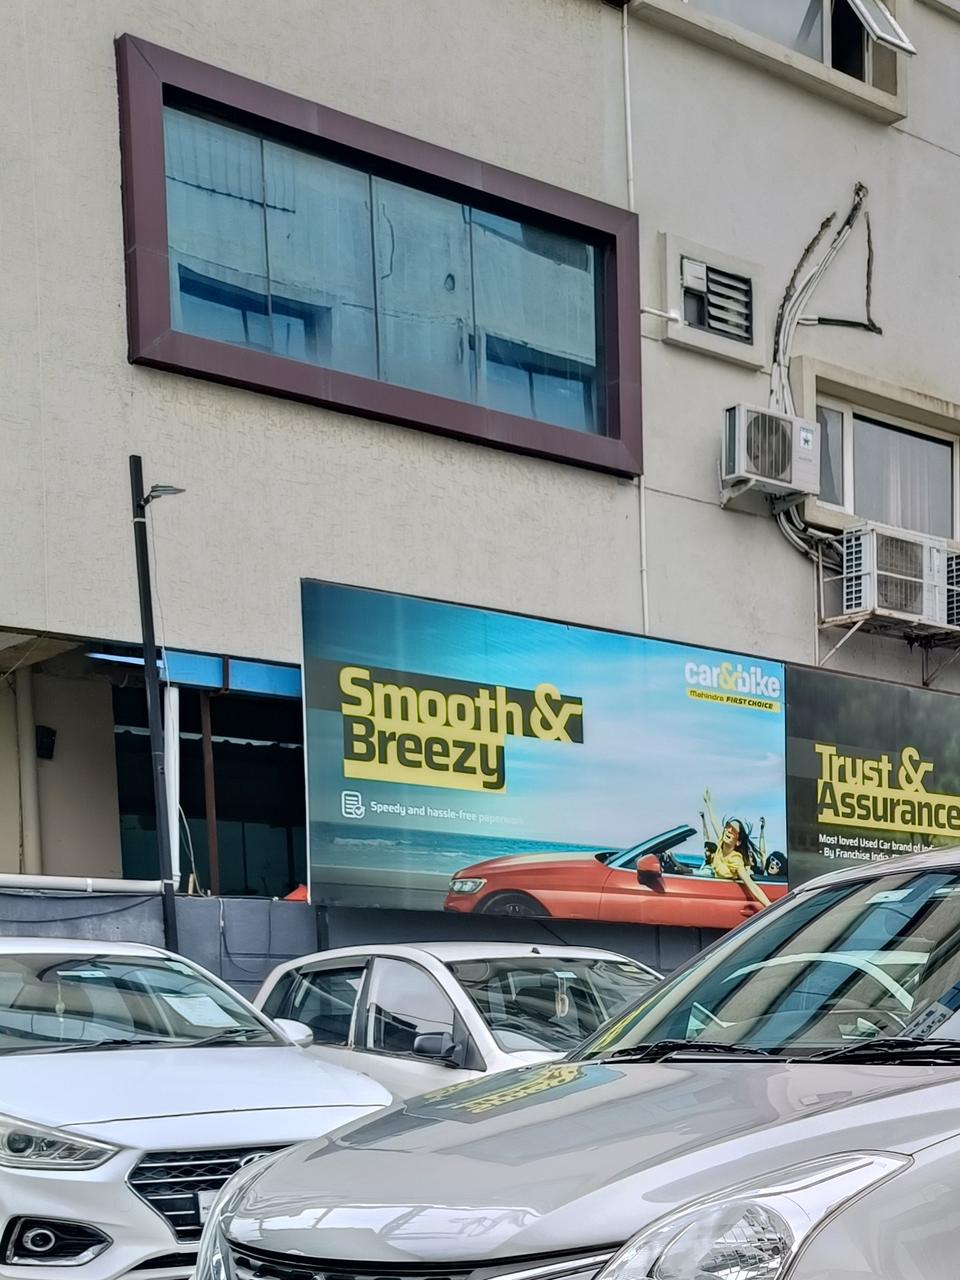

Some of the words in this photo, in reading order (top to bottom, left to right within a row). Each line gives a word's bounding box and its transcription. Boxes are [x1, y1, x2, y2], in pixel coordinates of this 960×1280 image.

[685, 662, 780, 697] car&bike
[338, 666, 524, 738] Smooth
[530, 683, 583, 743] &
[726, 696, 747, 705] FIRST
[748, 700, 773, 710] CHOICE
[344, 716, 505, 789] Breezy
[815, 744, 892, 788] Trust
[898, 746, 934, 793] &
[370, 801, 406, 816] Speedy
[408, 805, 425, 816] and
[427, 807, 477, 821] hassle-free
[818, 834, 837, 844] Most
[839, 835, 858, 847] loved
[860, 839, 878, 848] Used
[879, 840, 891, 850] Car
[892, 841, 912, 852] brand
[913, 843, 921, 853] of
[824, 847, 834, 859] By
[836, 849, 870, 860] Franchise
